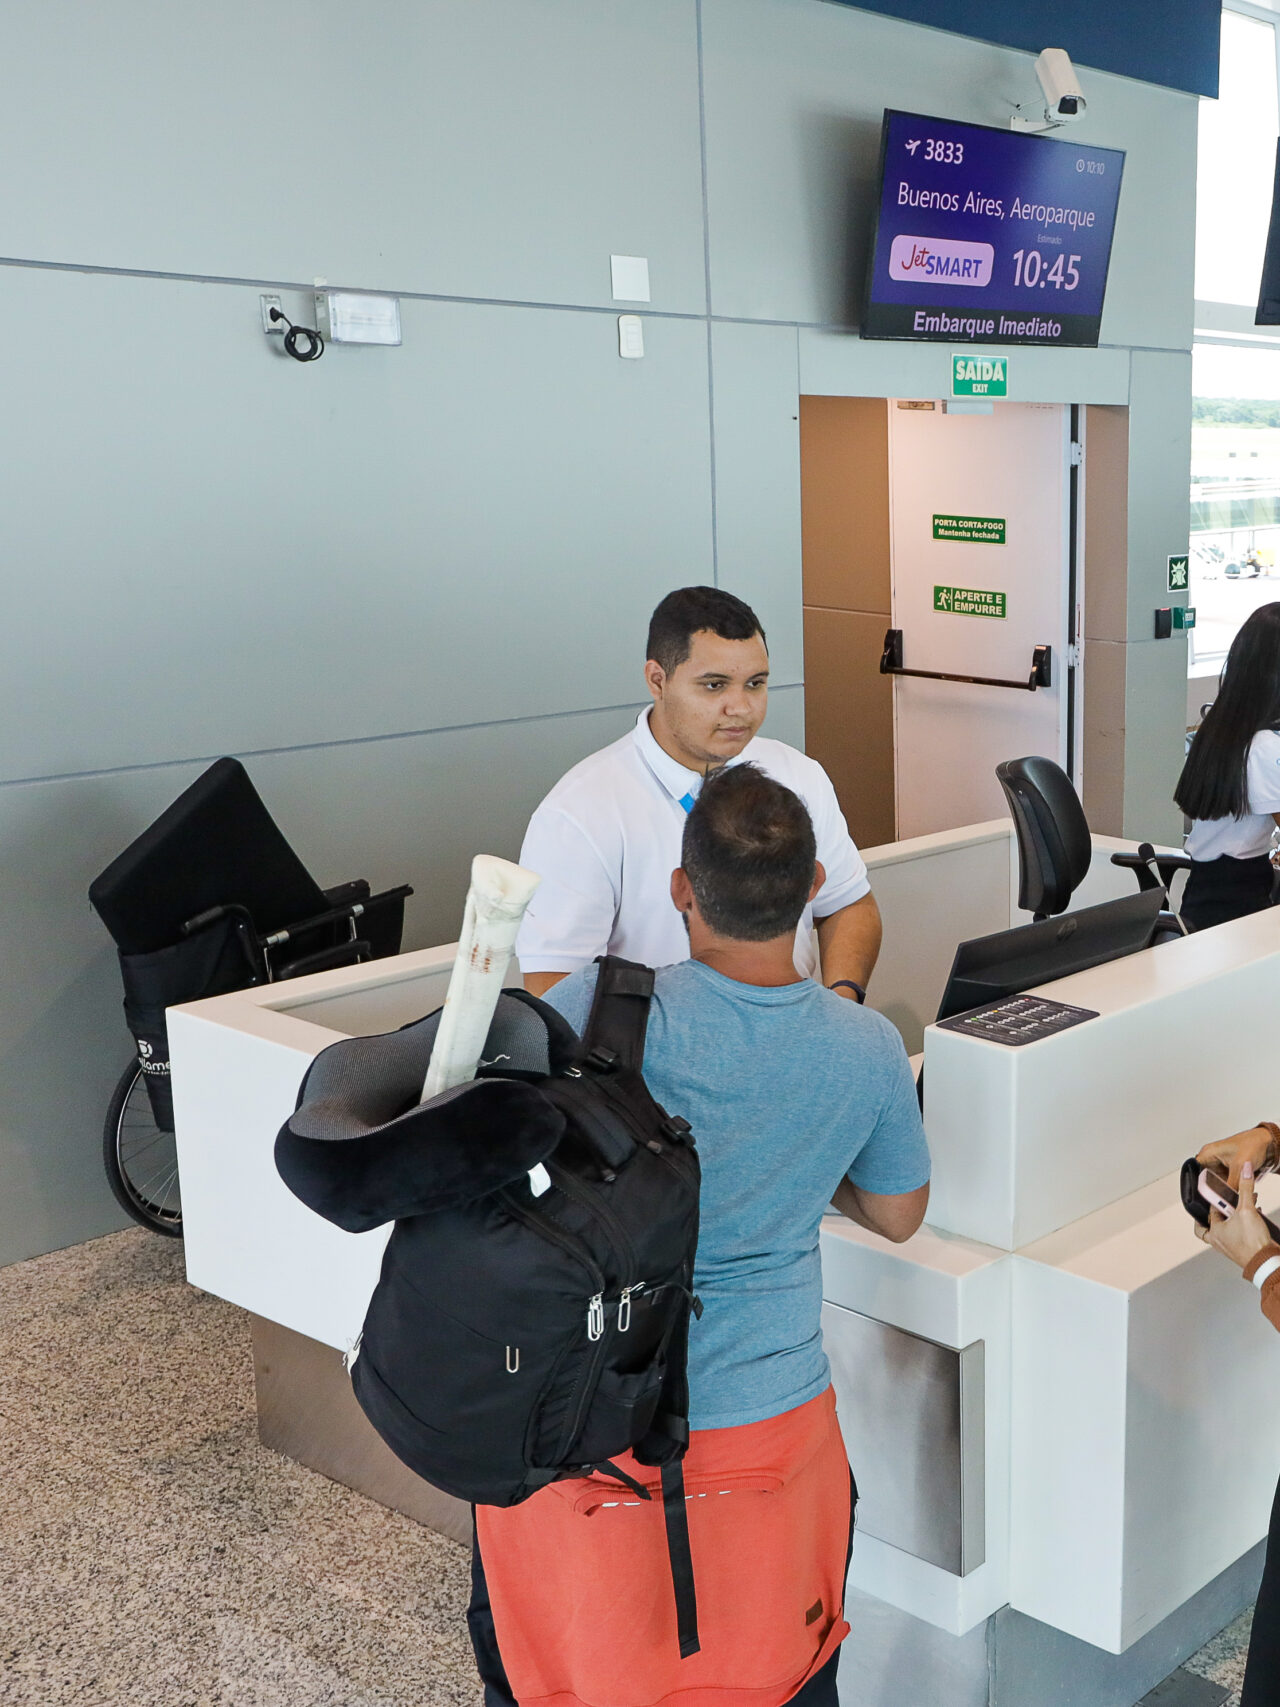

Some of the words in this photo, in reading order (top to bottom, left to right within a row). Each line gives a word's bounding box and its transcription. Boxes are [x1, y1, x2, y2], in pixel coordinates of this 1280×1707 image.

[924, 138, 964, 165] 3833
[897, 182, 959, 212] Buenos
[963, 191, 1006, 220] Aires,
[1010, 197, 1095, 230] Aeroparque
[901, 244, 983, 278] JetSMART
[1012, 249, 1082, 291] 10:45
[913, 311, 995, 336] Embarque
[998, 316, 1062, 337] Imediato
[955, 357, 1004, 381] SAÍDA
[972, 383, 989, 394] EXIT
[934, 518, 958, 528] PORTA
[958, 520, 1004, 531] CORTA-FOGO
[938, 528, 971, 538] Mantenha
[972, 531, 1000, 540] fechada
[954, 590, 993, 603] APERTE
[995, 594, 1002, 605] E
[954, 602, 1003, 616] EMPURRE
